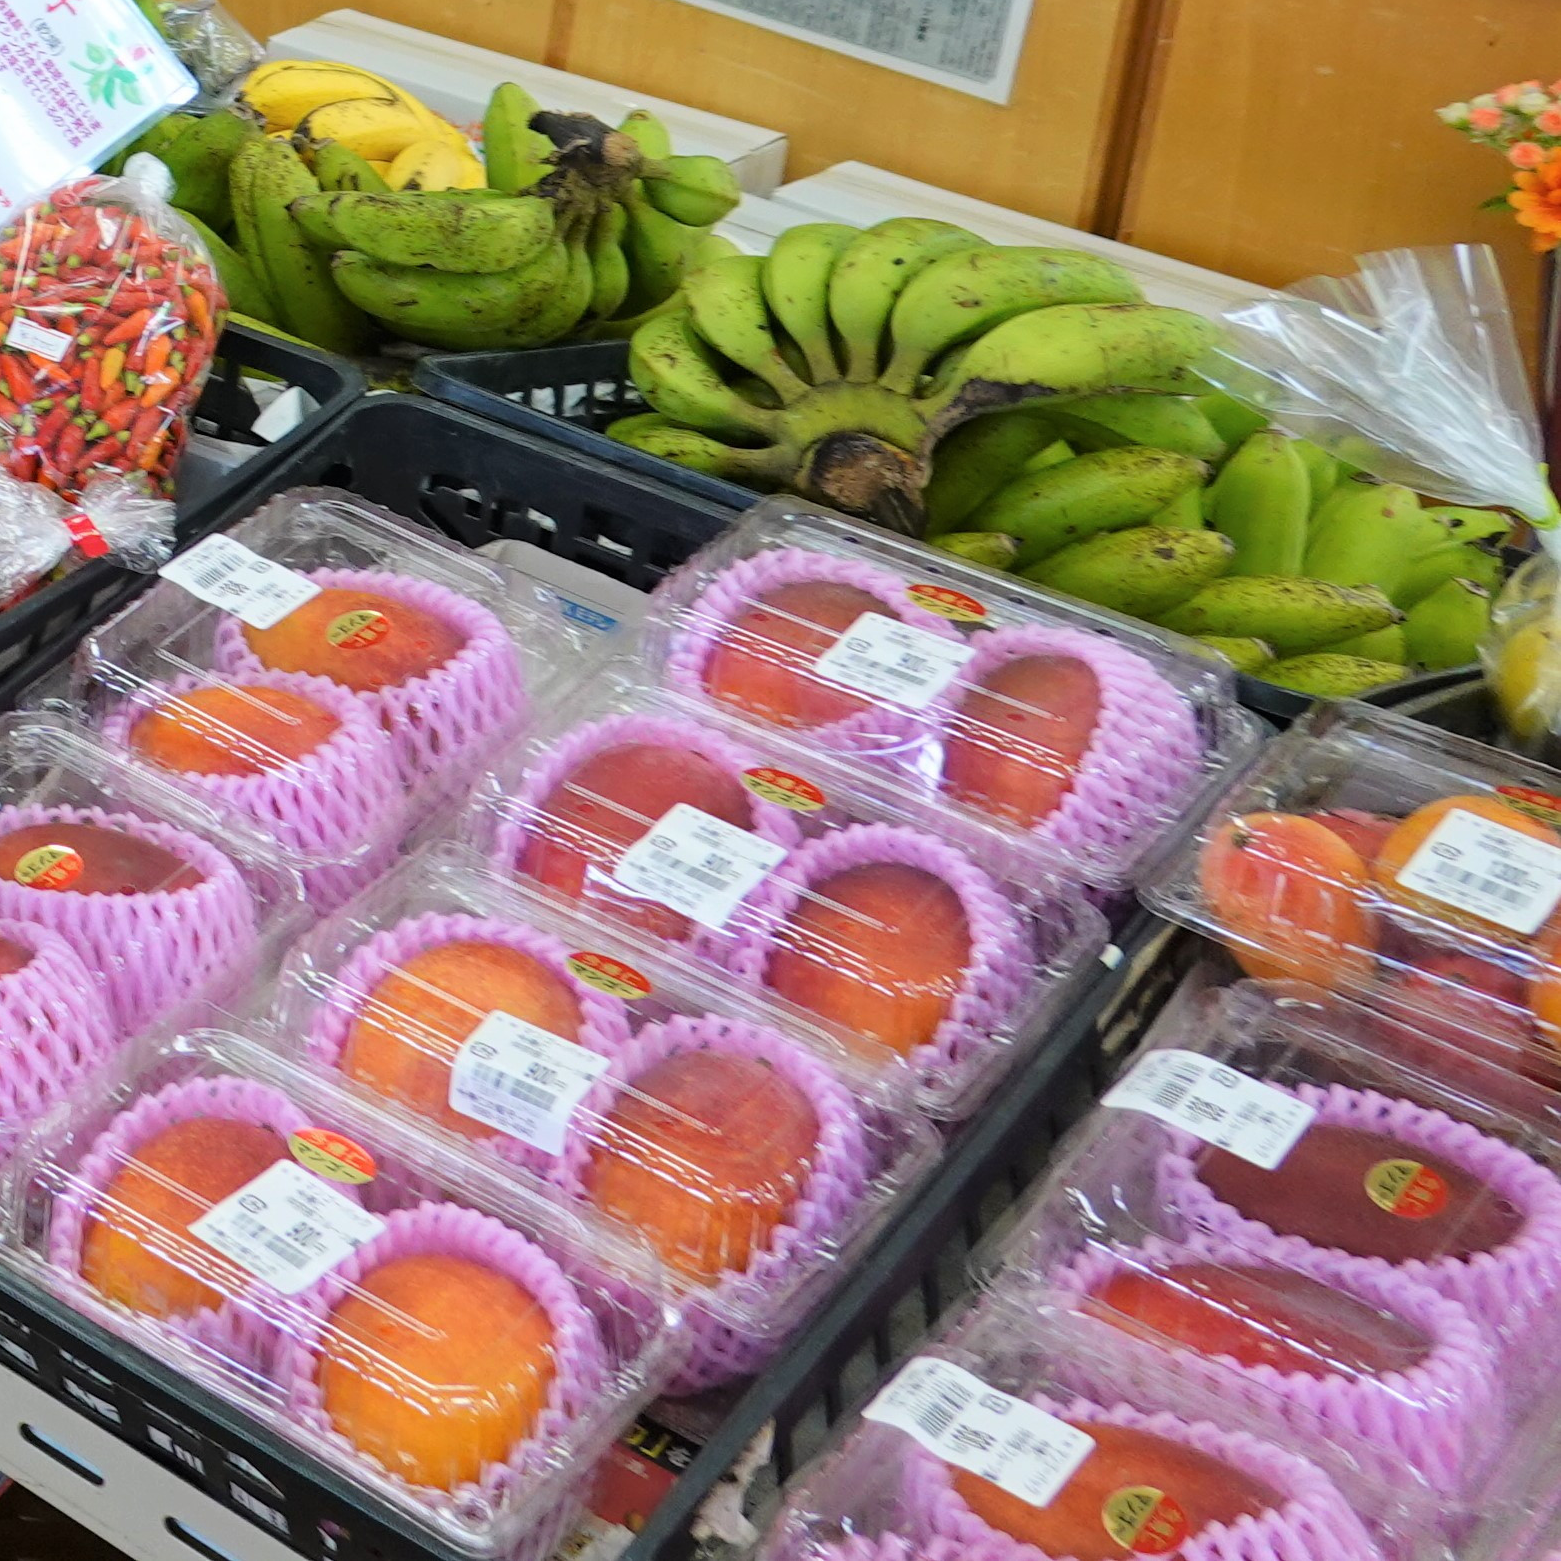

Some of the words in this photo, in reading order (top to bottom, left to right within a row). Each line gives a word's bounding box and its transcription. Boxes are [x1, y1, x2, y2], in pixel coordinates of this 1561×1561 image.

[912, 594, 970, 617] マンゴー
[746, 779, 807, 807] マンゴー
[700, 851, 745, 884] 900円
[569, 961, 636, 1000] マンゴー
[523, 1061, 568, 1089] 900円
[294, 1141, 360, 1181] マンゴー
[284, 1221, 328, 1254] 900円
